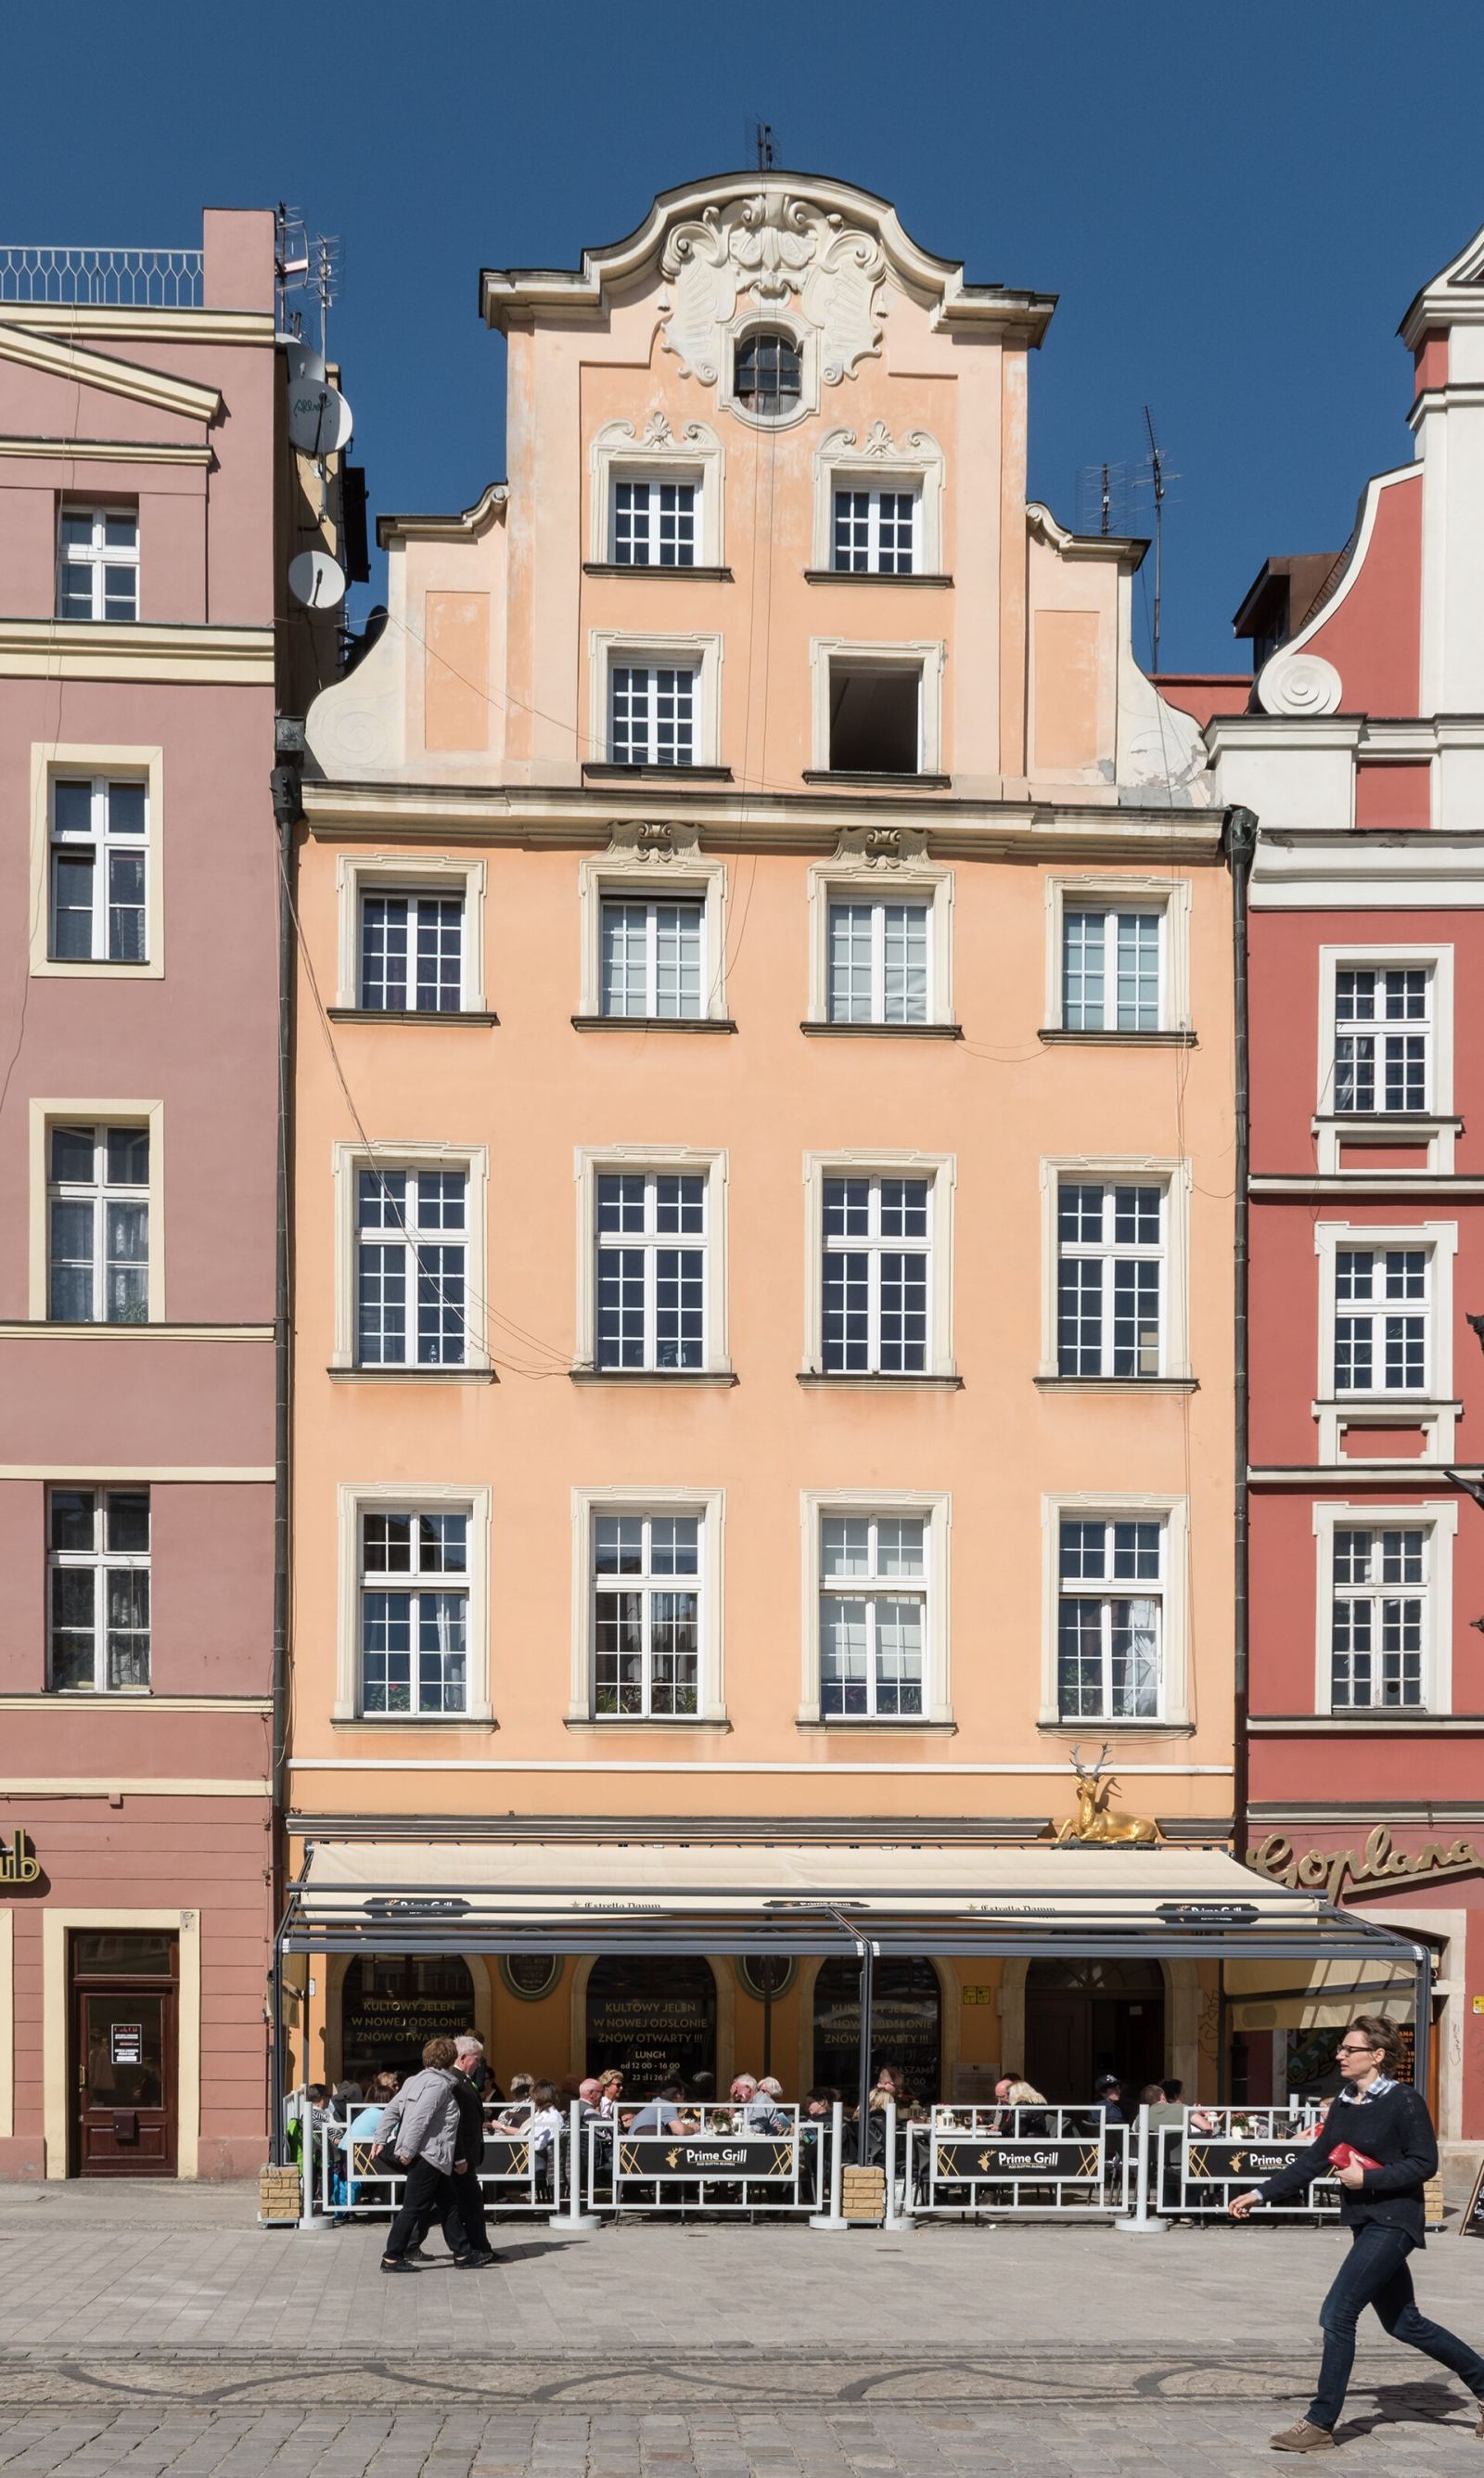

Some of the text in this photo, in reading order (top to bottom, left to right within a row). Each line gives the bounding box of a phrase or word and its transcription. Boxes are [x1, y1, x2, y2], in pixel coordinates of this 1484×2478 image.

[1246, 1824, 1484, 1907] Goplana
[364, 2002, 417, 2011] KULTOWY
[605, 2003, 660, 2012] KULTOWY
[352, 2017, 363, 2026] W
[365, 2017, 406, 2026] NOWEJ
[594, 2019, 605, 2027] W
[607, 2019, 647, 2027] NOWEJ
[356, 2029, 393, 2042] ZNÓW
[598, 2031, 634, 2043] ZNÓW
[636, 2034, 692, 2043] OTWARTY
[824, 2032, 861, 2044] ZNÓW
[872, 2034, 917, 2044] TWARTY
[634, 2050, 666, 2059] LUNCH
[686, 2148, 748, 2163] Prime Grill
[998, 2151, 1059, 2165] Prime Grill
[1249, 2153, 1283, 2166] Prime
